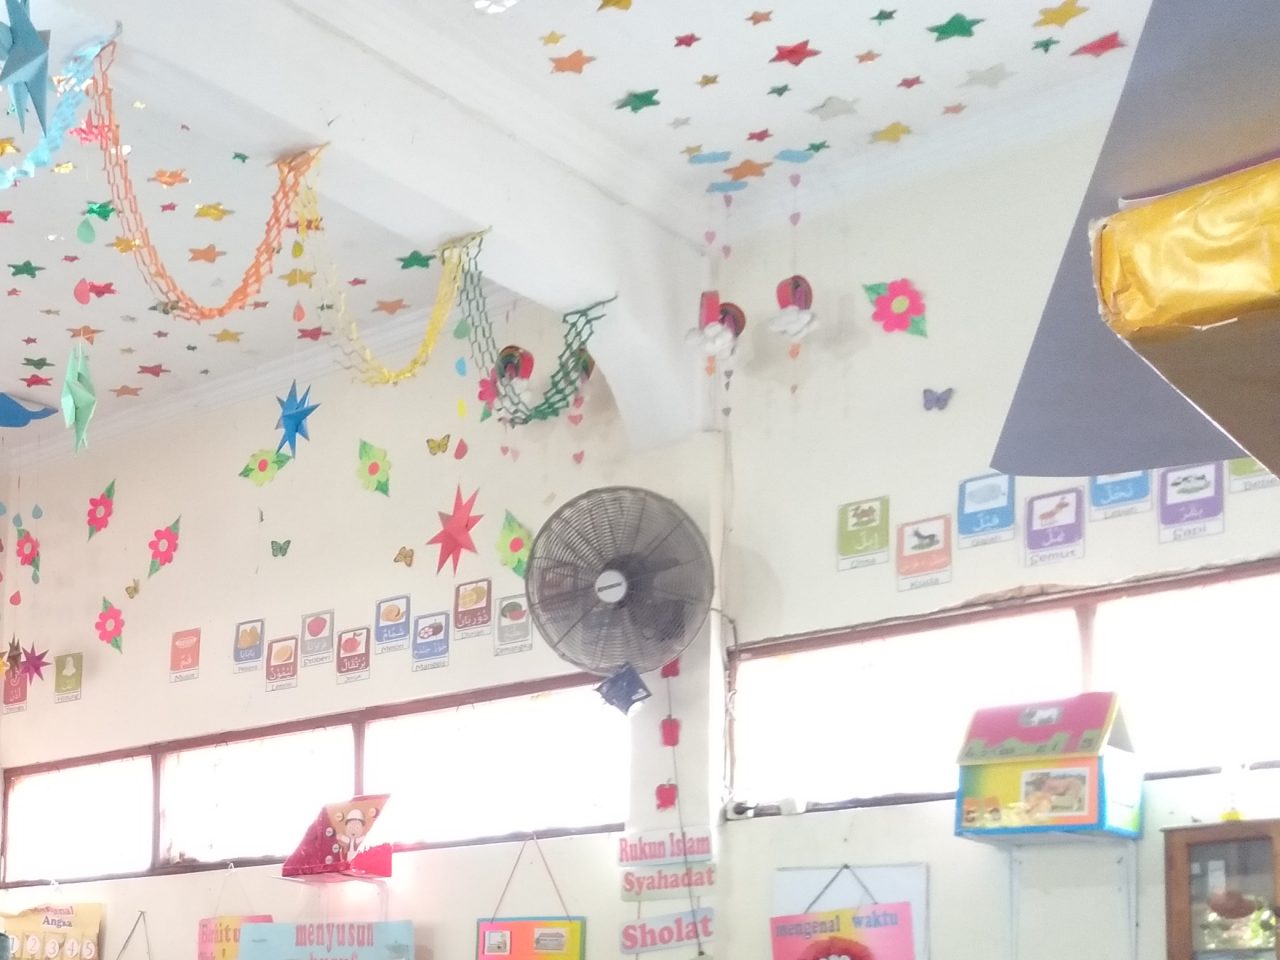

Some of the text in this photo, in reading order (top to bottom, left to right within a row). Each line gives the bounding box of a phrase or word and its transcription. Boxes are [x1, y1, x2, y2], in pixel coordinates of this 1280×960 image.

[619, 831, 710, 863] Rukun Islam
[623, 866, 715, 896] Syahadat
[295, 922, 374, 953] menyusun
[622, 914, 713, 950] Sholat
[776, 910, 898, 940] mengenal waktu
[49, 941, 57, 955] 3
[86, 943, 93, 956] 5
